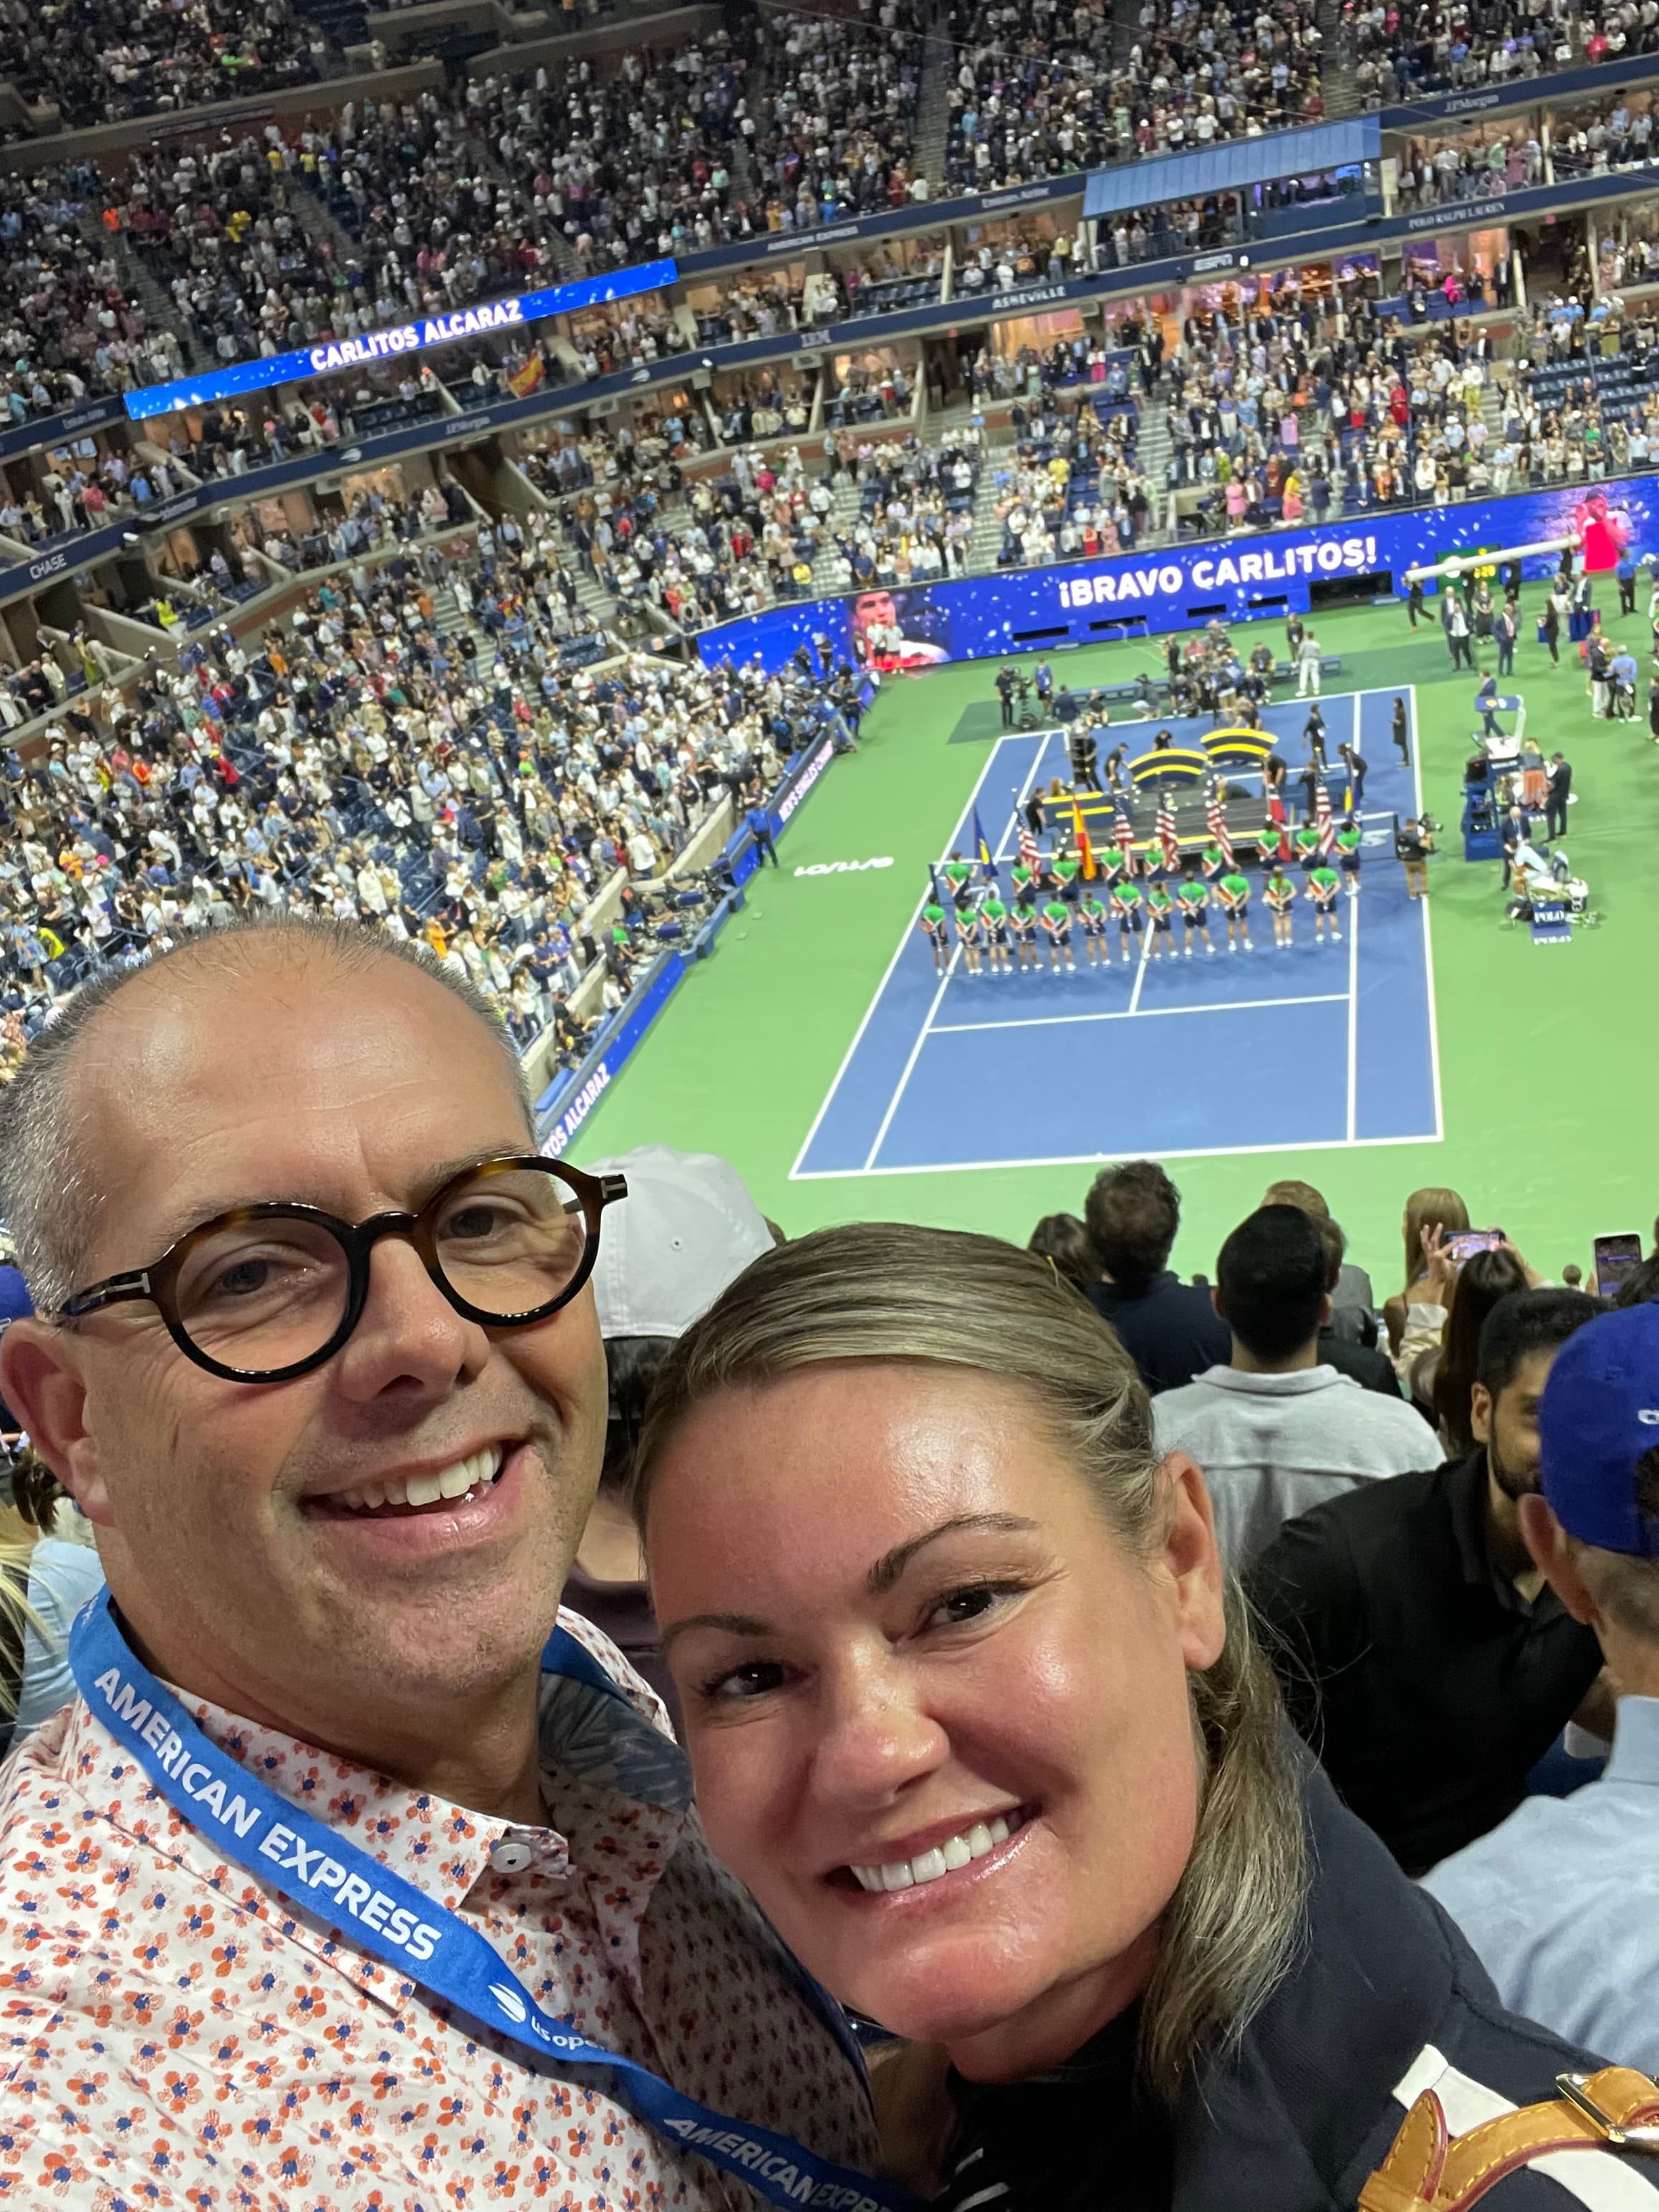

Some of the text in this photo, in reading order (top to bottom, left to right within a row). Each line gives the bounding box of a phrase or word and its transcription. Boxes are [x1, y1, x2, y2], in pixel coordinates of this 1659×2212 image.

[1193, 253, 1233, 271] ESPN
[309, 299, 524, 371] CARLITOS ALCARAZ
[30, 553, 67, 580] CHASE
[1058, 537, 1376, 607] ¡BRAVO CARLITOS!
[564, 1062, 611, 1136] ALCARAZ
[94, 1668, 443, 1961] AMERICAN EXPRESS
[663, 2118, 821, 2205] AMERICAN
